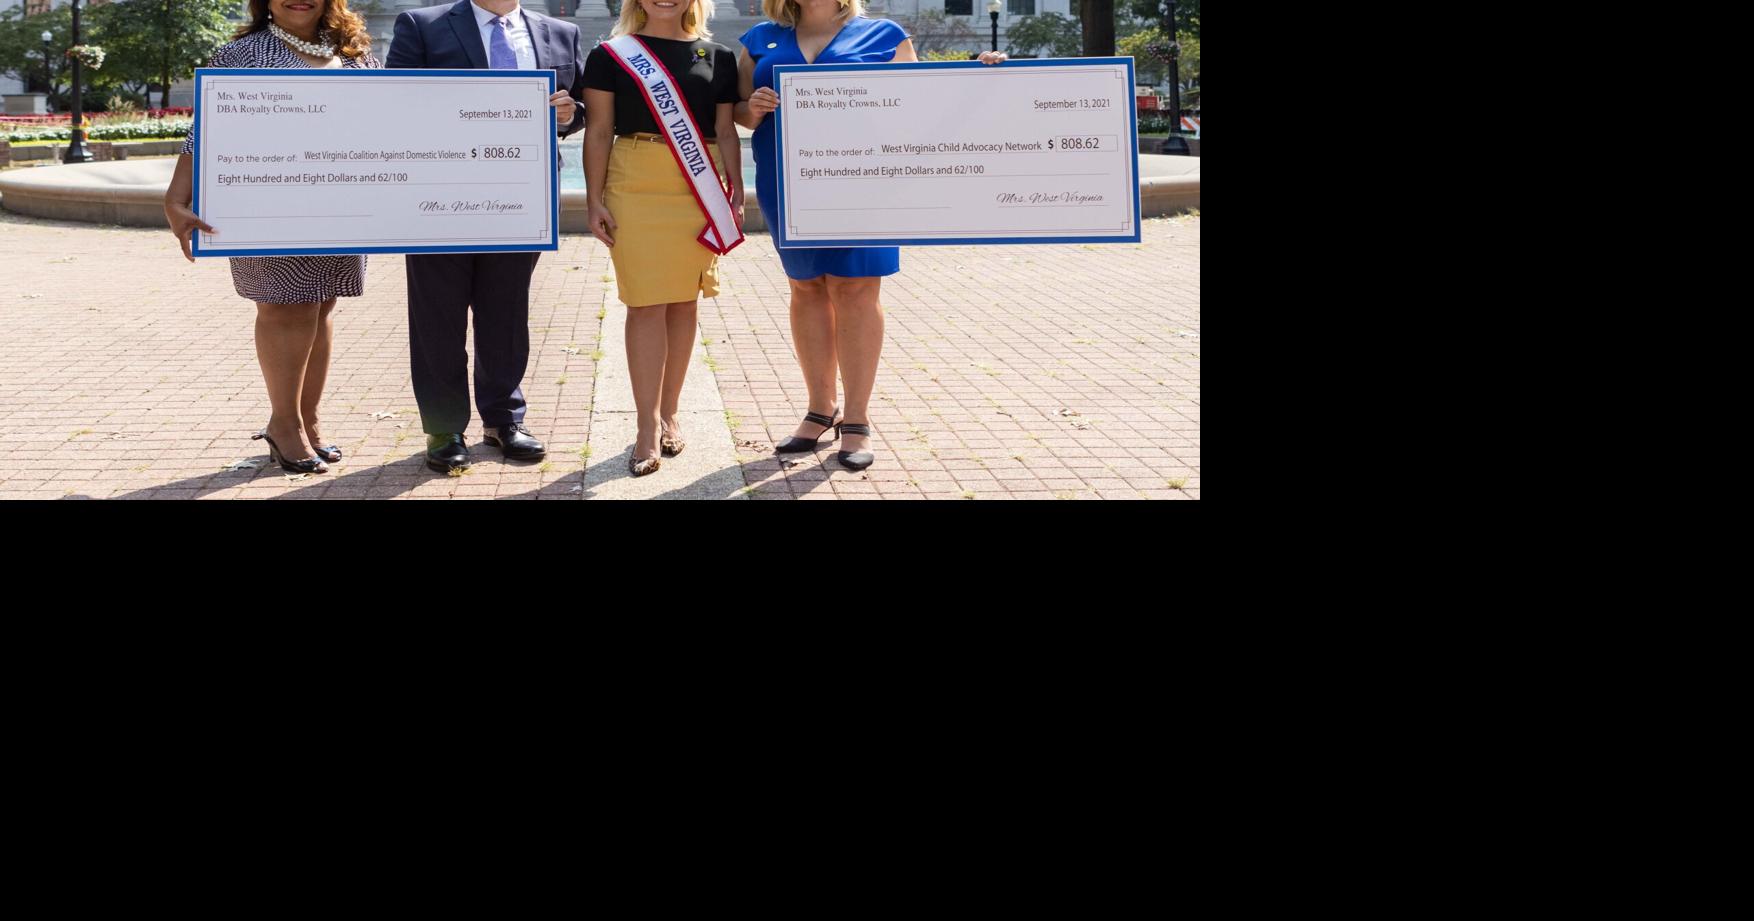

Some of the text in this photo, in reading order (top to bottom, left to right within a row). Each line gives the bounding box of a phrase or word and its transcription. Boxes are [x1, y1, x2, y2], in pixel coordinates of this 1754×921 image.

[218, 92, 293, 102] Mrs. West Virginia
[836, 87, 867, 97] Virginia
[217, 105, 326, 115] DBA Royalty Crowns, LLC
[796, 98, 901, 110] DBA Royalty Crowns, LLC
[1034, 100, 1077, 110] September
[1092, 99, 1110, 107] 2021
[459, 109, 500, 120] September
[627, 53, 707, 177] MRS. WEST VIRGINIA
[799, 149, 813, 158] Pay
[881, 144, 901, 153] West
[903, 144, 936, 155] Virginia
[938, 143, 959, 152] Child
[962, 143, 1003, 153] Advocacy
[1005, 141, 1042, 151] Network
[1048, 139, 1054, 149] $
[1061, 137, 1100, 149] 808.62
[218, 155, 232, 164] Pay
[304, 151, 321, 160] West
[322, 151, 347, 162] Virginia
[349, 150, 378, 160] Coalition
[380, 151, 405, 162] Against
[406, 150, 437, 159] Domestic
[438, 150, 466, 159] Violence
[471, 148, 477, 159] $
[484, 147, 520, 159] 808.62
[800, 165, 984, 179] Eight Hundred and Eight Dollars and 62/100
[218, 172, 408, 185] Eight Hundred and Eight Dollars and 62/100
[996, 191, 1103, 204] Mrs. West Virginia
[419, 200, 523, 212] Mrs. West Virginia
